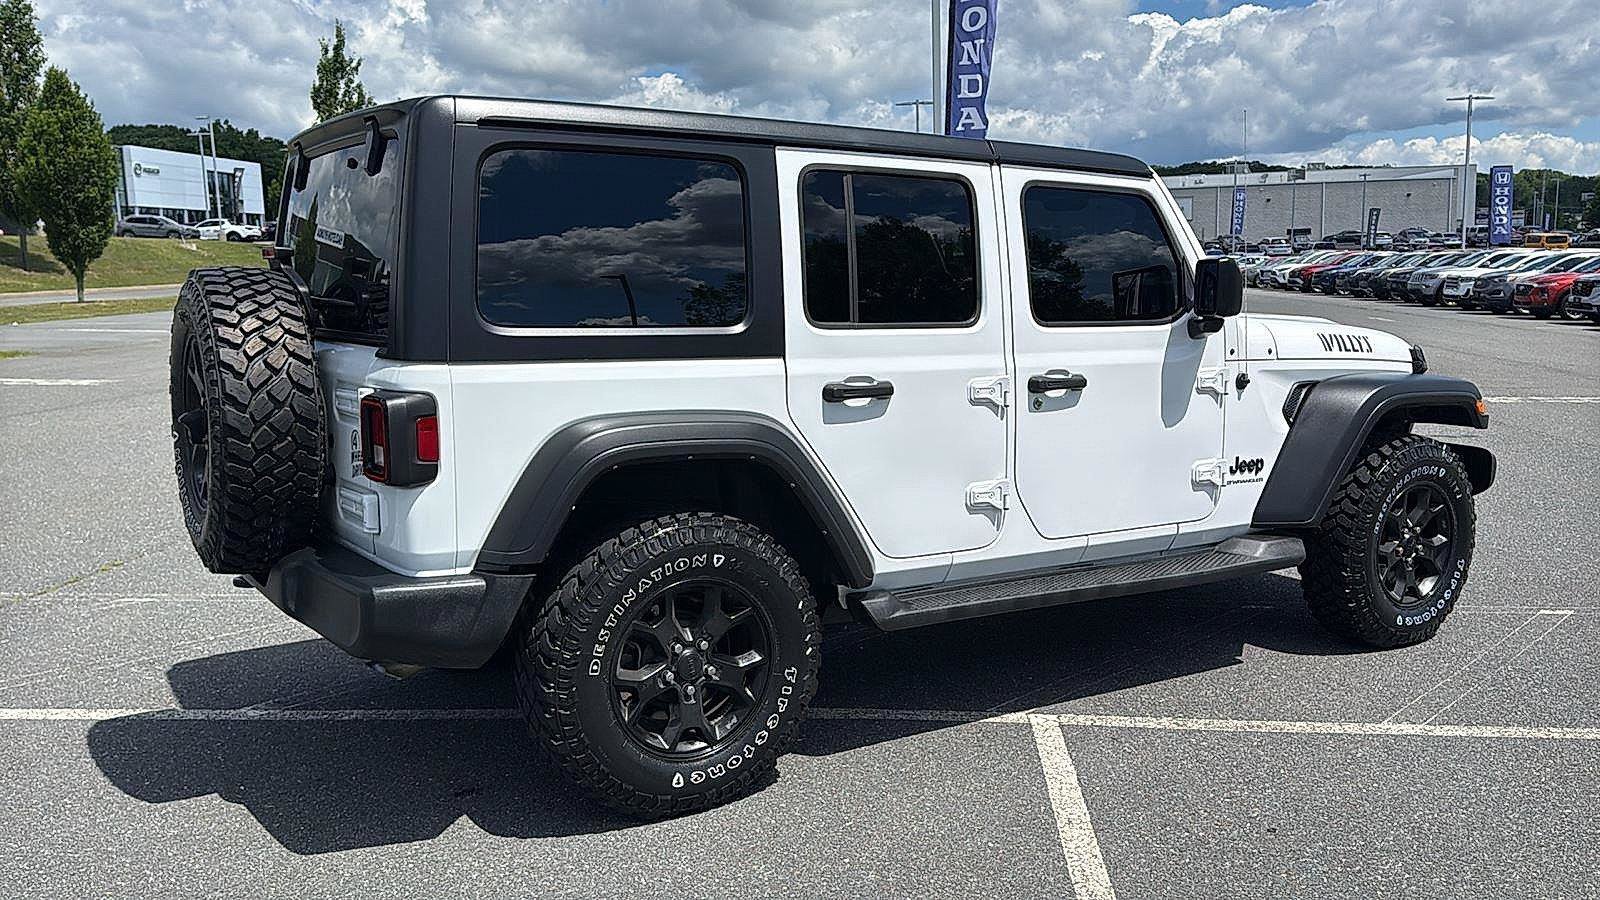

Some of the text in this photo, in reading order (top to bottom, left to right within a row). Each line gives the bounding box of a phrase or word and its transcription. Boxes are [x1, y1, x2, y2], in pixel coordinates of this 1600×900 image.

[956, 0, 988, 131] ONDA
[1234, 201, 1244, 230] HONDA
[1493, 187, 1510, 235] HONDA
[1316, 333, 1373, 353] WILLYS
[1229, 456, 1264, 476] Jeep
[1231, 477, 1264, 485] WRANGLER
[589, 553, 708, 677] DESTINATION
